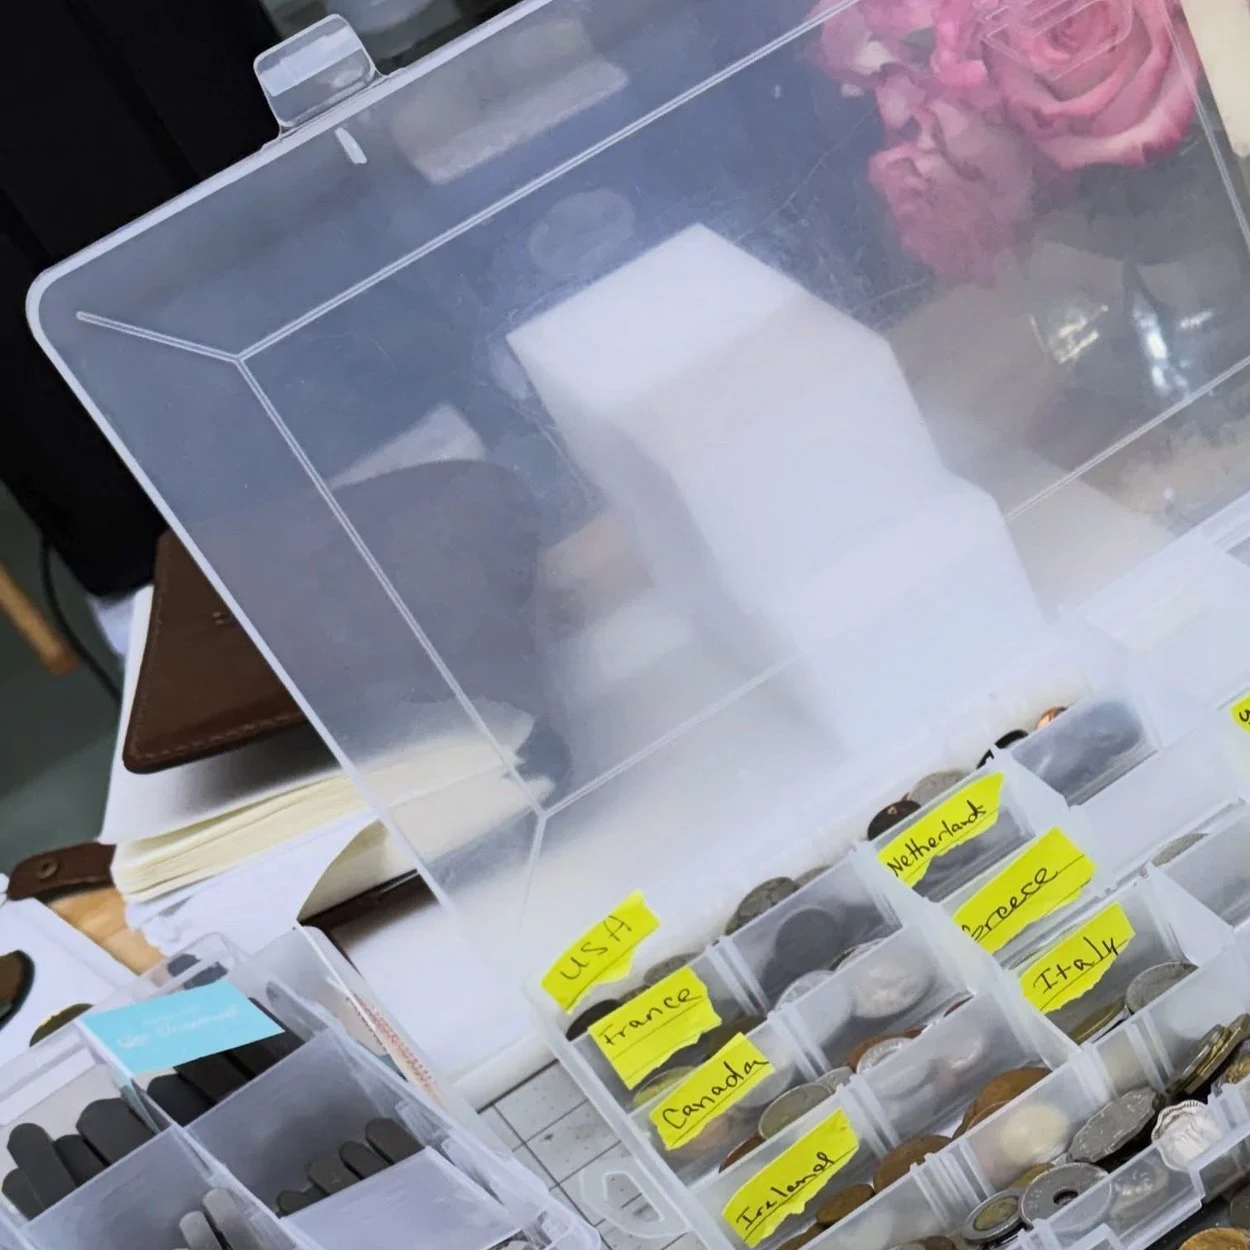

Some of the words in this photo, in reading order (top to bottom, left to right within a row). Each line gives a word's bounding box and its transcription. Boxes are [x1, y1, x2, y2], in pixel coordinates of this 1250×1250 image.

[559, 914, 634, 985] USA
[1033, 937, 1119, 994] Italy
[600, 984, 706, 1046] France
[663, 1052, 769, 1131] Canada
[738, 1151, 842, 1231] Ireland
